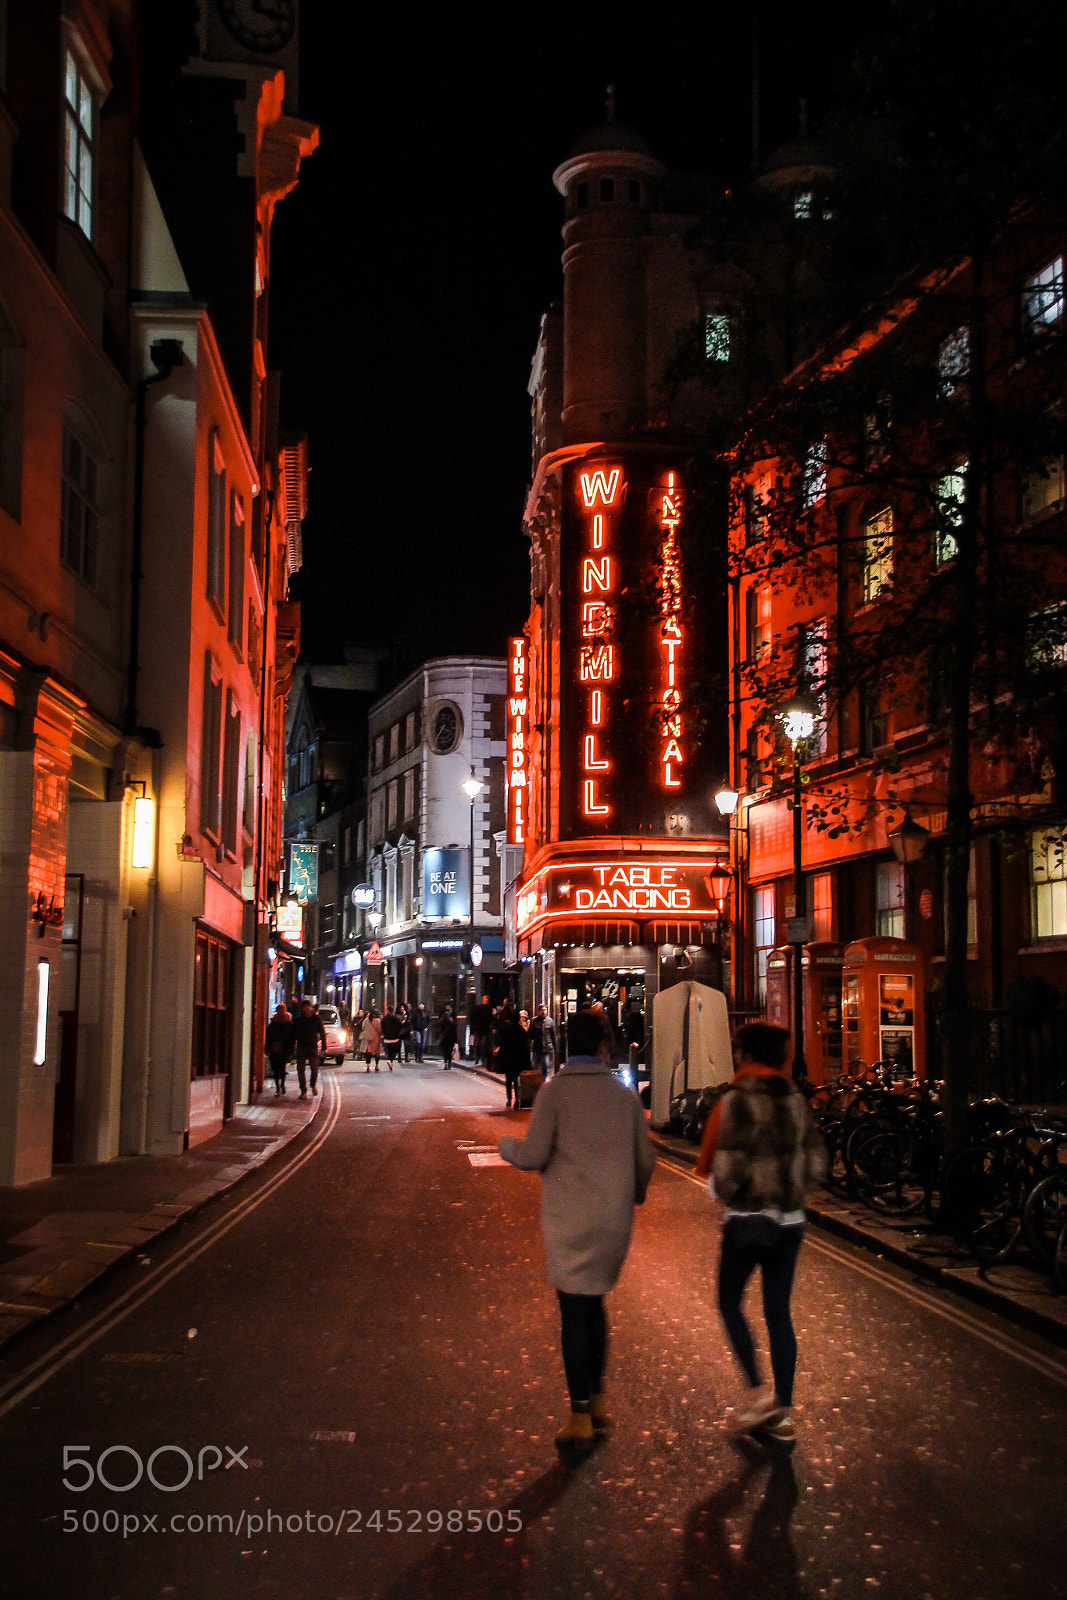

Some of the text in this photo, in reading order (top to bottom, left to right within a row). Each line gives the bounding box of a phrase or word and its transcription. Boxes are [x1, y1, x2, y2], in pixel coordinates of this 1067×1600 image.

[579, 468, 622, 817] WINDMILL
[508, 637, 527, 844] THE WINDMILL
[430, 871, 457, 882] BE AT
[593, 865, 678, 888] TABLE
[430, 883, 457, 894] ONE
[575, 887, 692, 910] DANCING
